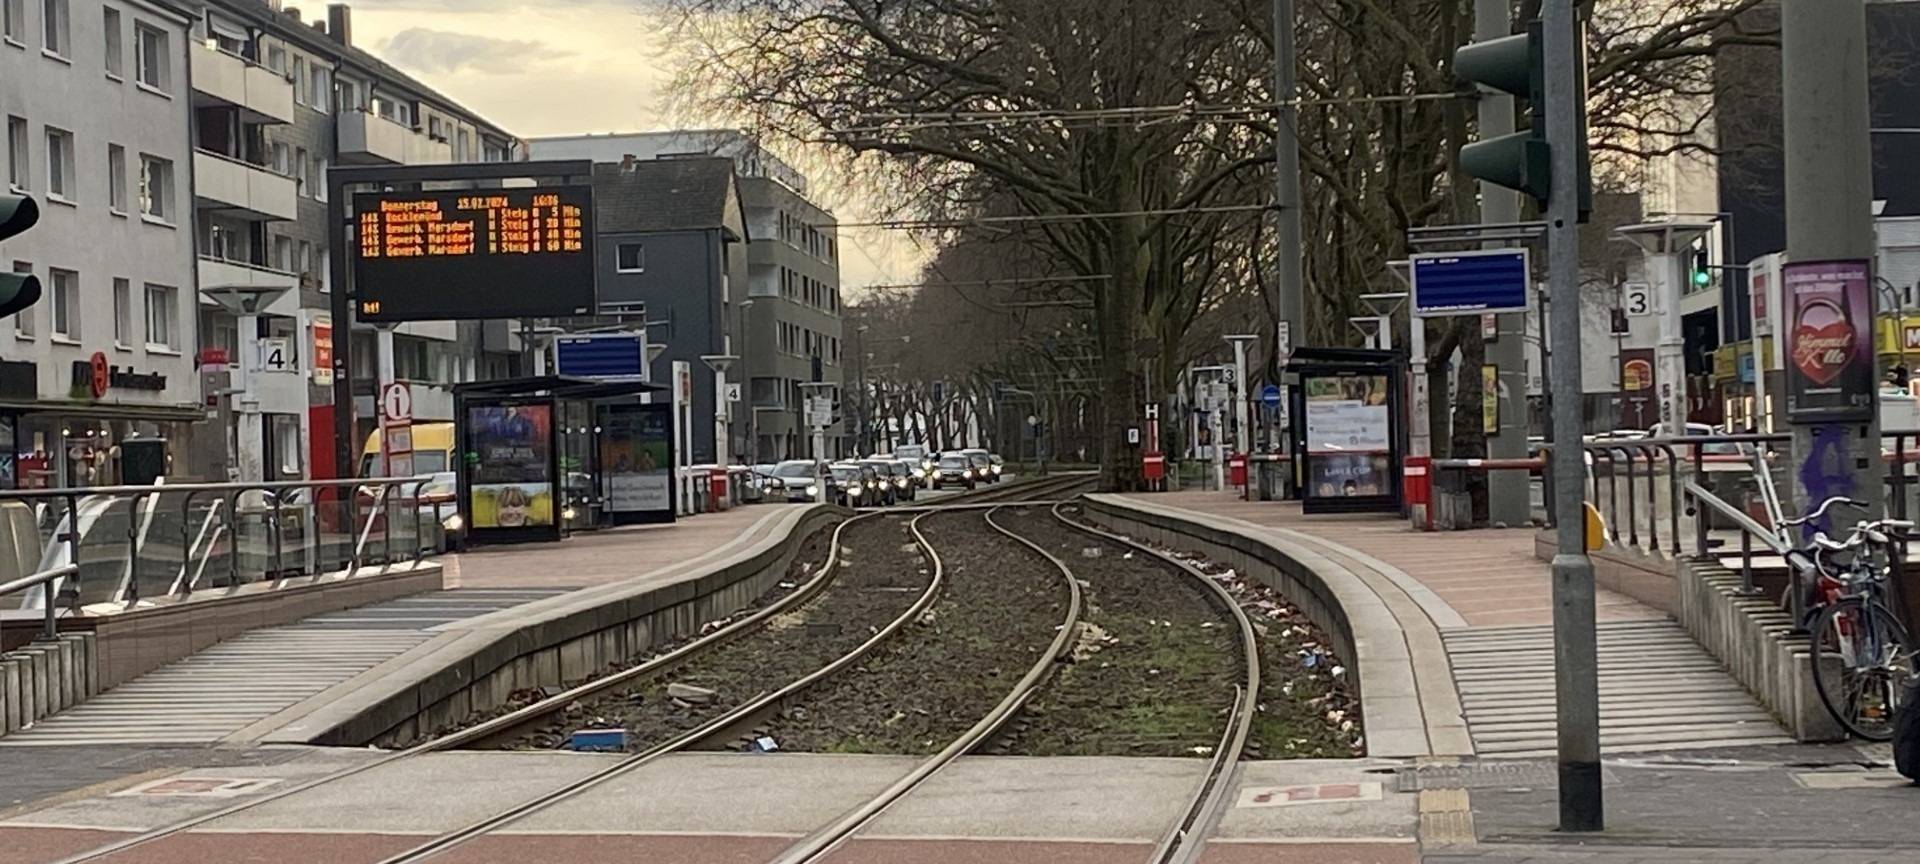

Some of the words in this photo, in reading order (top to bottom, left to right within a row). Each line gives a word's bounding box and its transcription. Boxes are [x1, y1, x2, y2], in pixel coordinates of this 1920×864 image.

[1629, 292, 1646, 314] 3
[268, 348, 285, 369] 4
[1793, 348, 1846, 369] Klle
[1225, 369, 1234, 381] 3
[729, 388, 738, 400] 4
[1145, 404, 1159, 419] H
